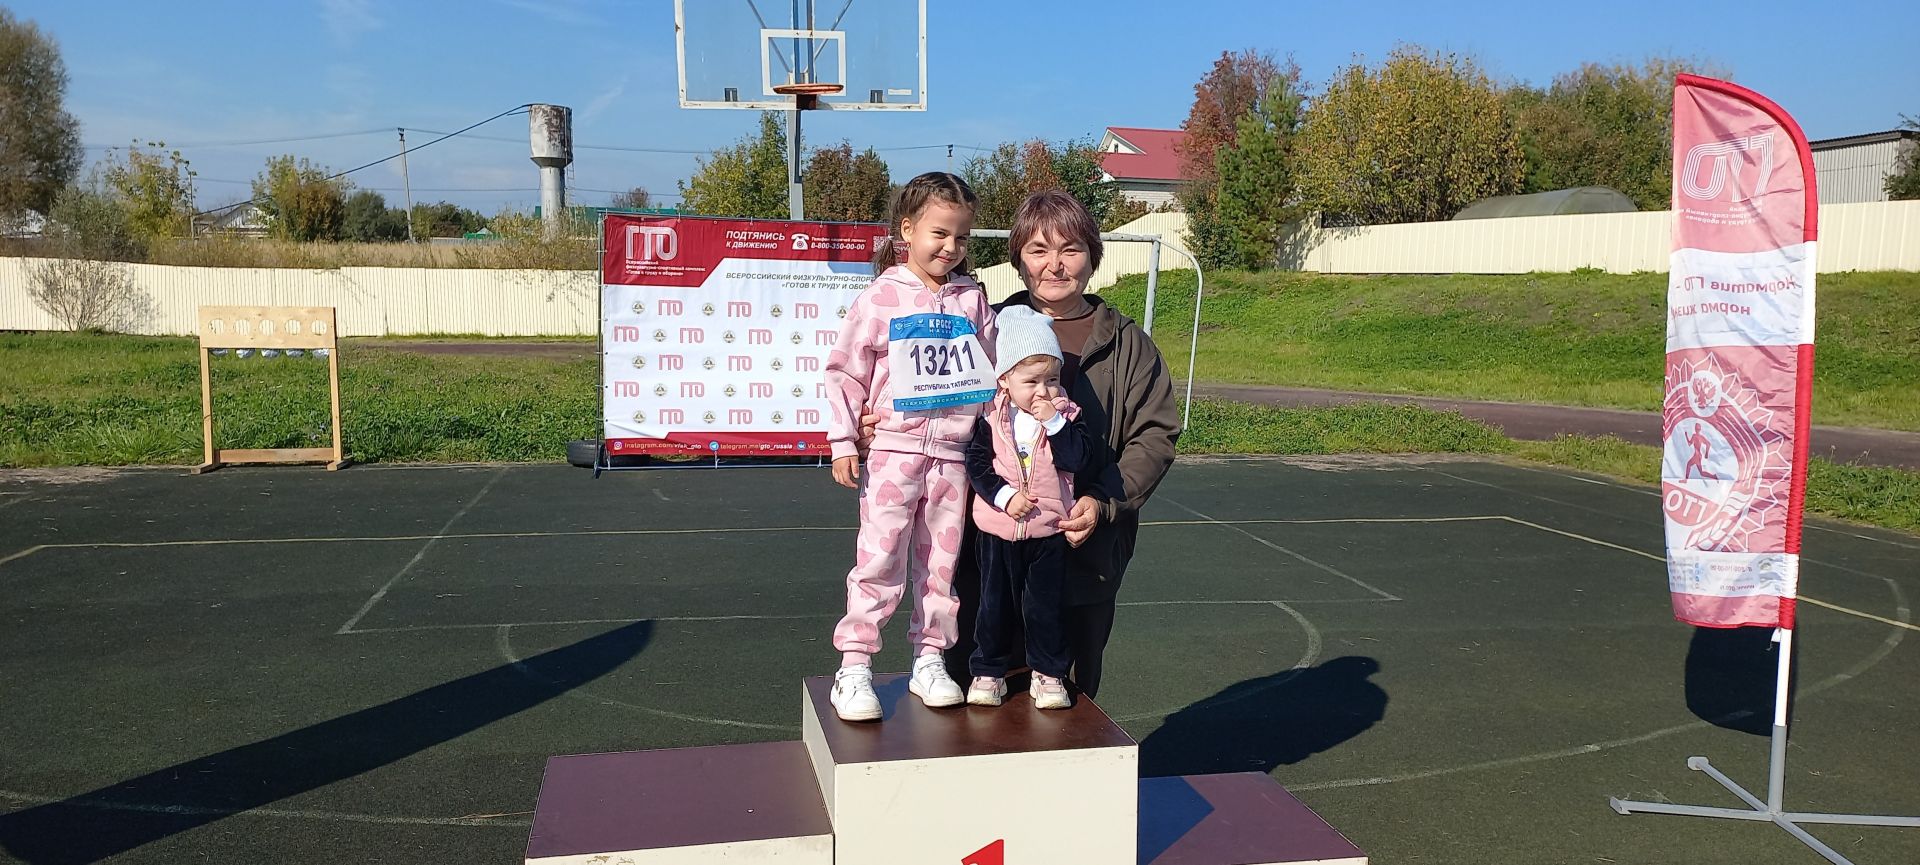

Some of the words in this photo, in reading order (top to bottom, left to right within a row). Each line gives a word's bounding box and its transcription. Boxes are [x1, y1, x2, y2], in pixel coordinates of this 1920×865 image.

[625, 225, 678, 261] ГТО
[725, 230, 786, 241] ПОДТЯНИСЬ
[732, 242, 778, 250] ДВИЖЕНИЮ
[811, 242, 865, 250] 8-800-350-00-00
[725, 272, 791, 281] ВСЕРОССИЙСКИЙ
[792, 274, 875, 283] ФИЗКУЛЬТУРНО-СПОРТ
[658, 299, 684, 316] ГТО
[727, 301, 752, 318] ГТО
[795, 303, 819, 319] ГТО
[614, 325, 640, 342] ГТО
[679, 327, 705, 344] ГТО
[748, 329, 773, 345] ГТО
[815, 329, 839, 346] ГТО
[658, 354, 684, 371] ГТО
[728, 355, 753, 372] ГТО
[795, 356, 820, 372] ГТО
[910, 340, 976, 376] 13211
[614, 381, 640, 398] ГТО
[680, 381, 705, 398] ГТО
[749, 382, 774, 399] ГТО
[914, 383, 951, 392] РЕСПУБЛИКА
[951, 379, 982, 389] ТАТАРСТАН
[659, 408, 685, 425] ГТО
[728, 408, 753, 425] ГТО
[796, 408, 820, 425] ГТО
